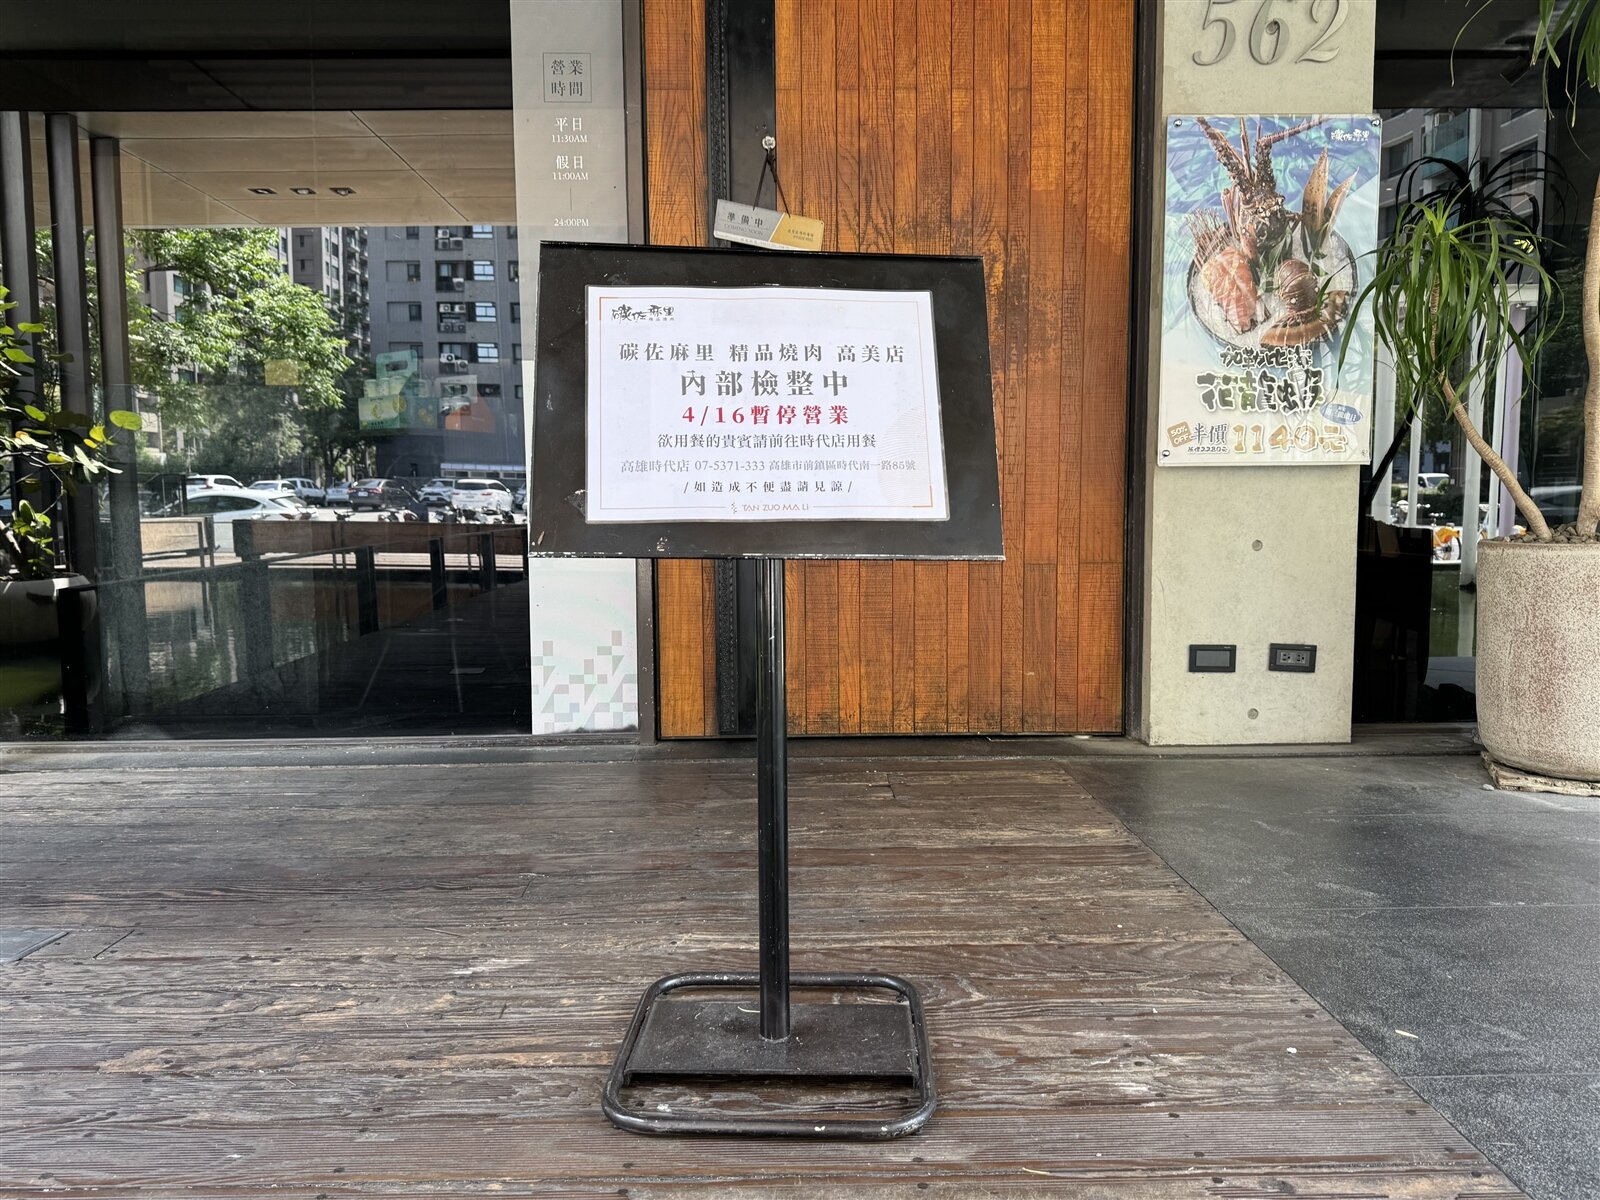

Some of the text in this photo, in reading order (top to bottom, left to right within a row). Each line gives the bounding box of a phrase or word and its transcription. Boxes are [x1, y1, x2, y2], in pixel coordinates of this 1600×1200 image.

[1192, 0, 1349, 66] 562
[550, 59, 583, 76] 營業
[551, 80, 583, 97] 時間
[554, 117, 583, 132] 平日
[551, 134, 588, 143] 11:30AM
[556, 155, 584, 170] 假日
[552, 172, 589, 181] 11:00AM
[554, 218, 589, 227] 24:00PM
[727, 211, 764, 228] 準備中
[618, 343, 905, 363] 碳佐麻里 精品燒肉 高美店
[680, 370, 849, 397] 內部檢整中
[682, 405, 849, 426] 4/16暫停營業
[1170, 425, 1188, 437] 50%
[1194, 422, 1228, 444] 半價
[1231, 423, 1348, 453] 1140元
[657, 434, 877, 449] 欲用餐的貴賓請前往時代店用餐
[1173, 433, 1190, 445] OFF
[620, 459, 917, 473] 高雄時代店 07-5371-333 高雄市前鎮區時代南一路85號
[742, 503, 760, 512] TAN
[762, 503, 781, 512] ZUO
[782, 503, 800, 512] MA
